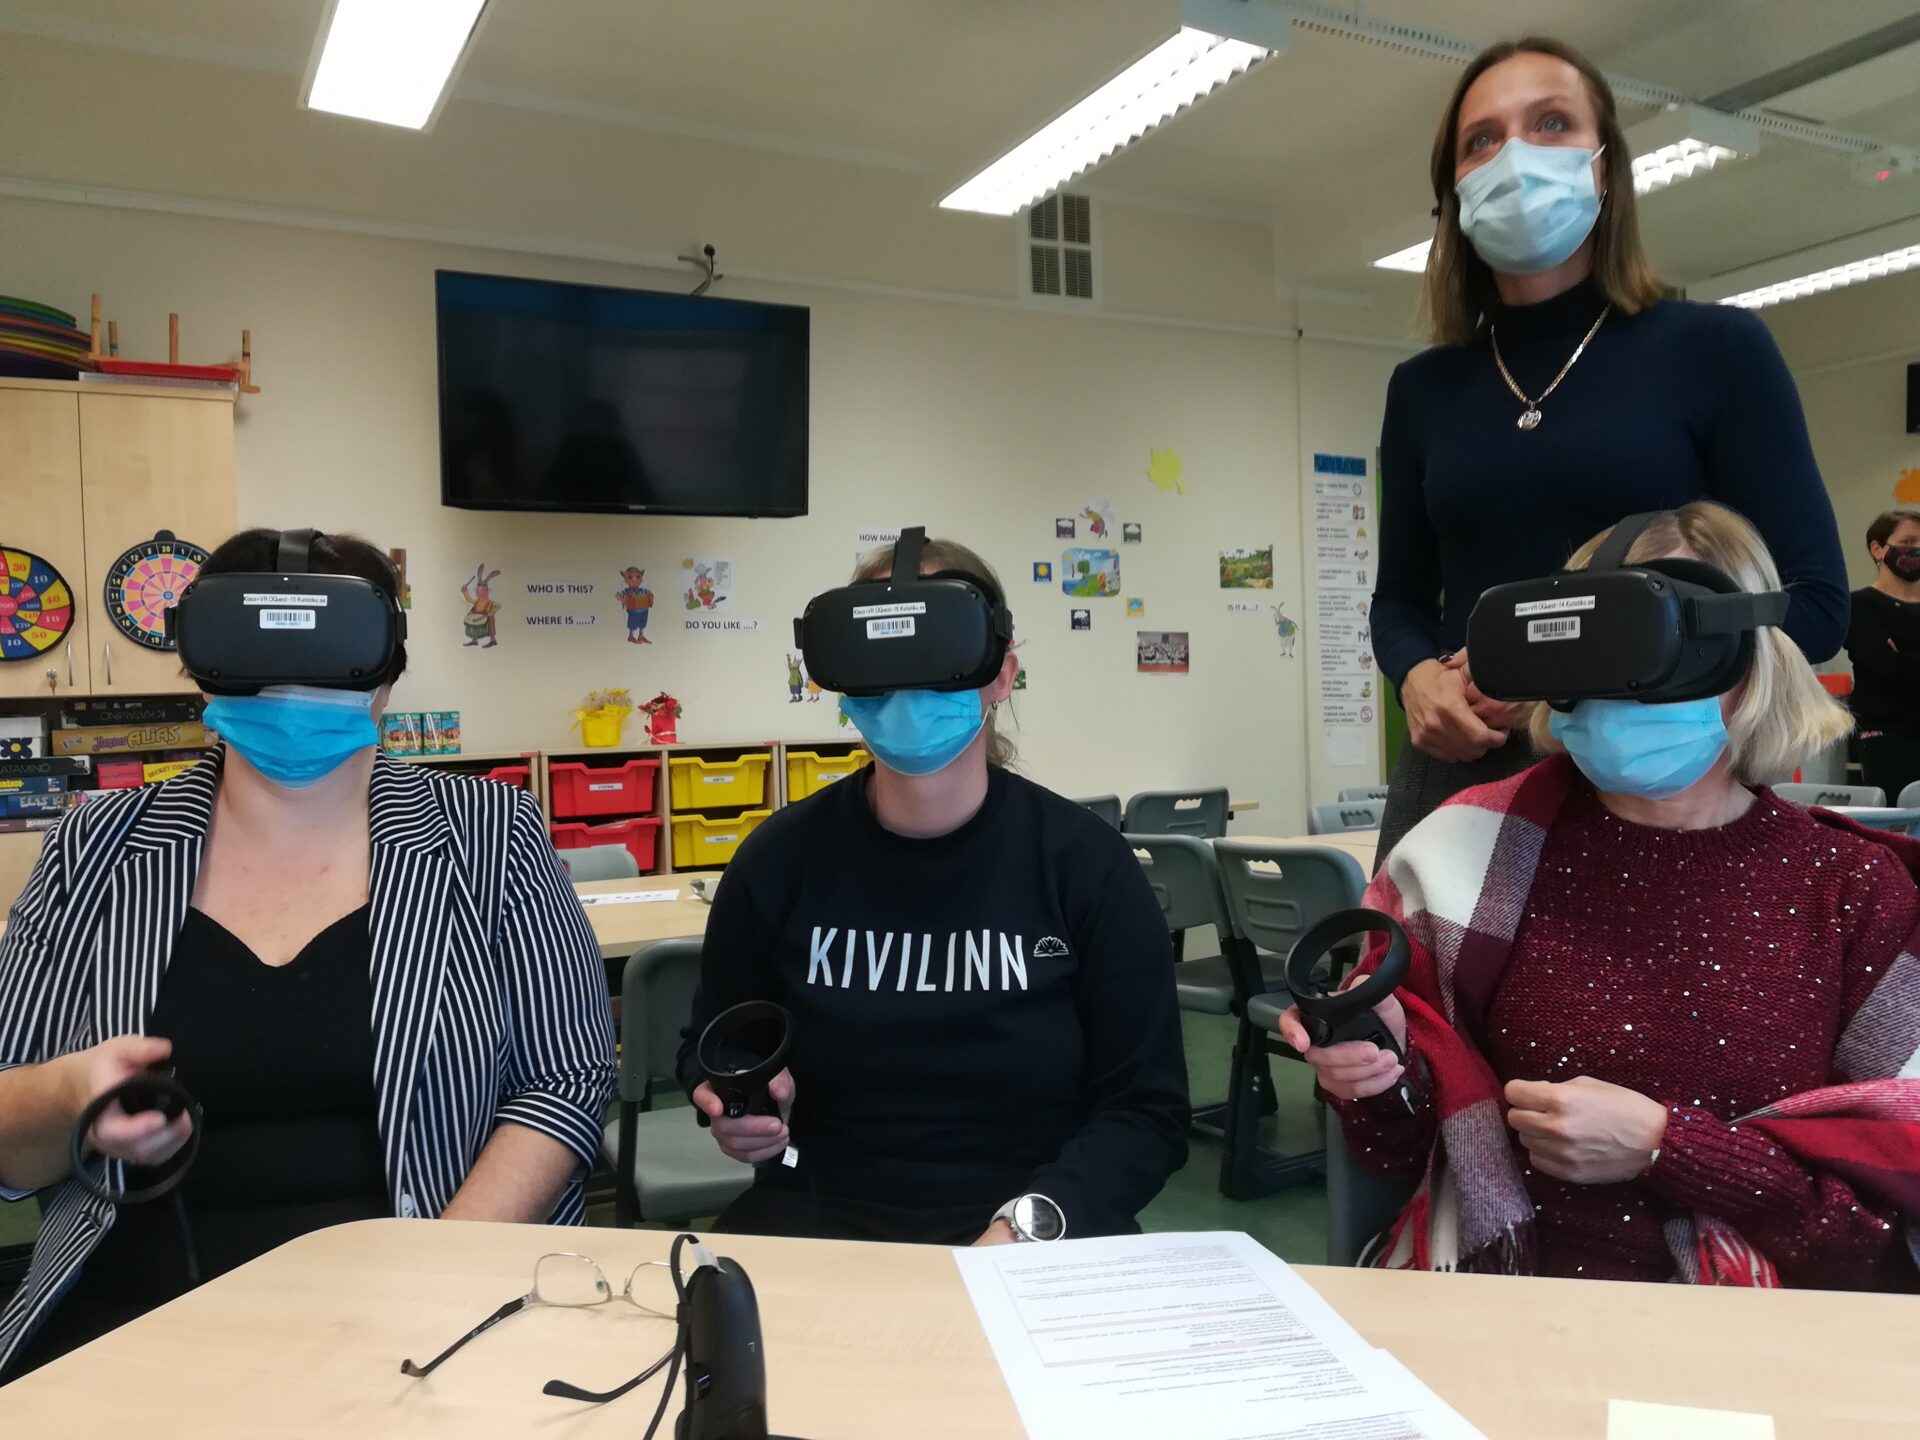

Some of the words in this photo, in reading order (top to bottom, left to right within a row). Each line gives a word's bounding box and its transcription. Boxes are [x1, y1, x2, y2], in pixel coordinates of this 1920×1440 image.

[859, 533, 878, 542] HOW
[161, 545, 171, 553] 20
[13, 563, 26, 572] 30
[34, 574, 48, 584] 10
[527, 584, 553, 593] WHO
[556, 584, 565, 593] IS
[567, 584, 594, 594] THIS?
[46, 594, 60, 604] 40
[46, 615, 60, 623] 10
[526, 616, 563, 625] WHERE
[565, 616, 574, 625] IS
[685, 620, 700, 629] DO
[702, 620, 721, 629] YOU
[723, 620, 741, 629] LIKE
[31, 631, 47, 640] 50
[7, 639, 21, 647] 10
[806, 926, 1028, 992] KIVILINN
